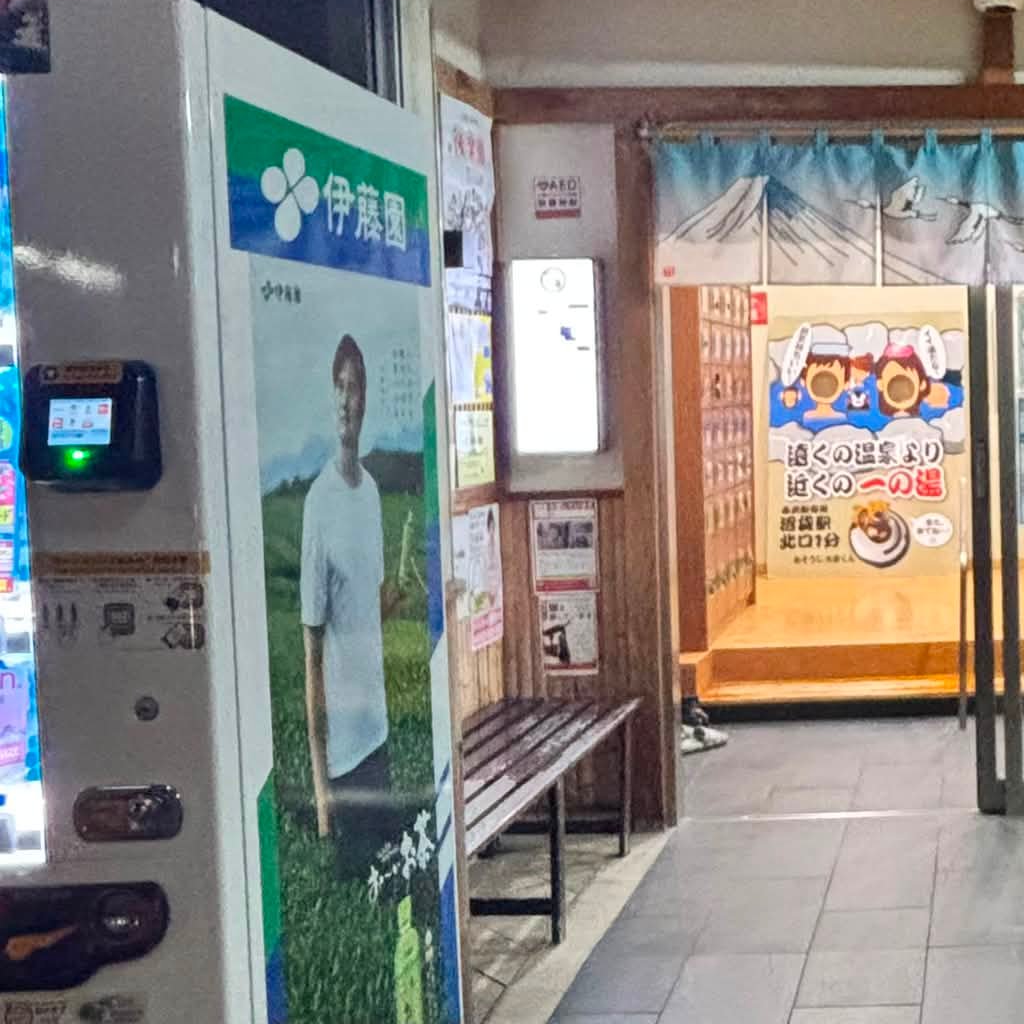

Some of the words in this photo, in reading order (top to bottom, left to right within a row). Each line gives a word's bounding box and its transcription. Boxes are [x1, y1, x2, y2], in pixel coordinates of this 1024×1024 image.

[322, 171, 407, 252] 伊藤園
[787, 441, 941, 467] 遠くの温泉より
